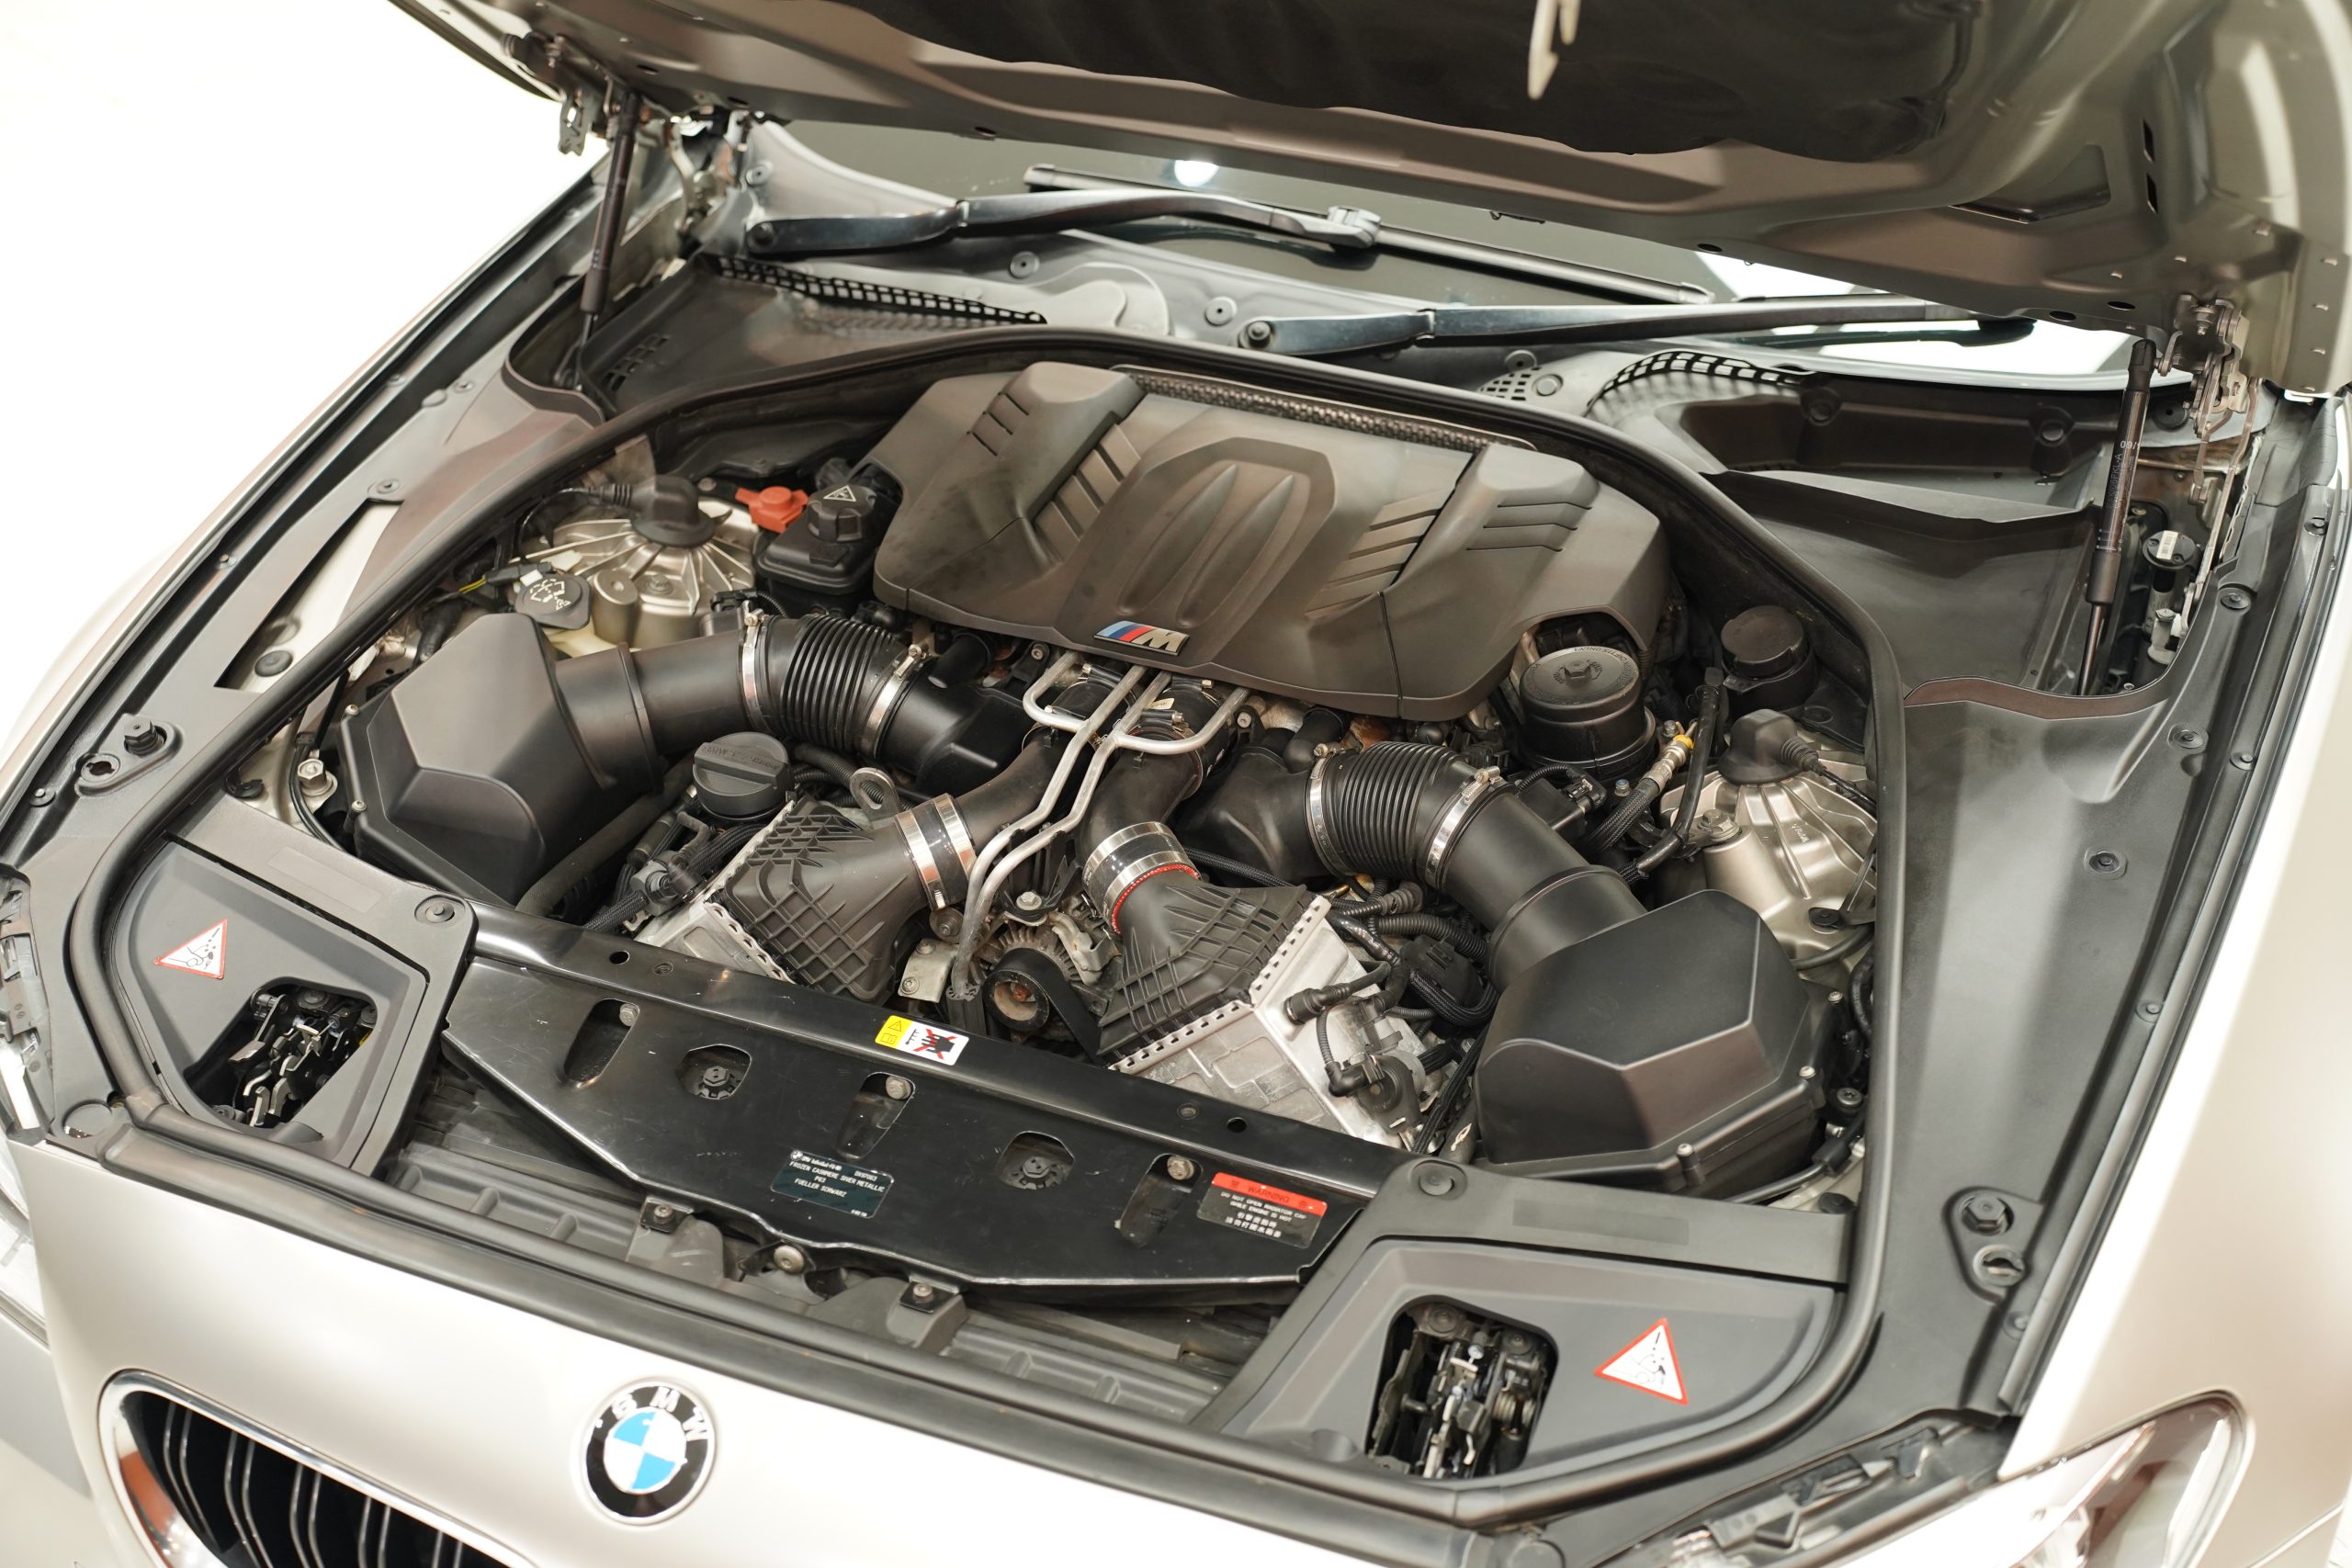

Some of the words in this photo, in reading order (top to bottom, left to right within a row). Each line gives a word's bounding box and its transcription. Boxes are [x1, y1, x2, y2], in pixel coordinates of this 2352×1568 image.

[789, 1161, 811, 1172] FROZEN
[856, 1179, 885, 1192] METALLIC
[794, 1179, 820, 1190] FUELLER
[1232, 1194, 1245, 1202] NOT
[1248, 1186, 1289, 1202] WARNING
[611, 1385, 709, 1441] BMW
